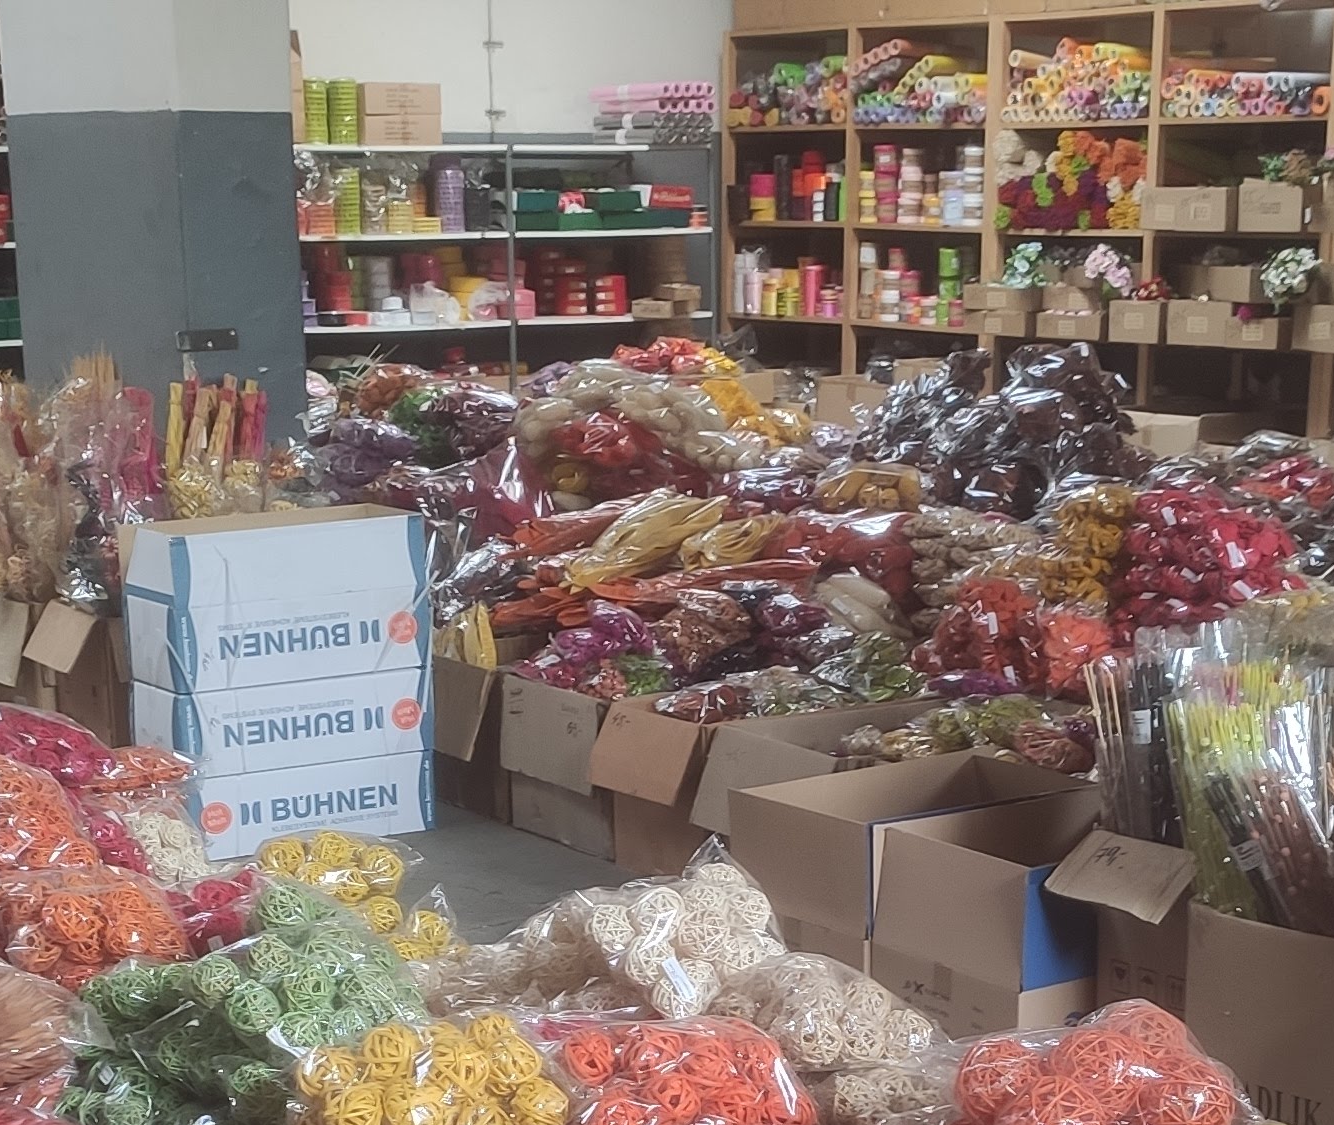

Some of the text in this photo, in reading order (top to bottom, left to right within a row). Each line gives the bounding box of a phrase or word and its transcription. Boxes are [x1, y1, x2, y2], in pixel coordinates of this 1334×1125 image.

[219, 622, 351, 660] BÜHNEN
[223, 710, 354, 748] BÜHNEN
[271, 783, 398, 822] BÜHNEN
